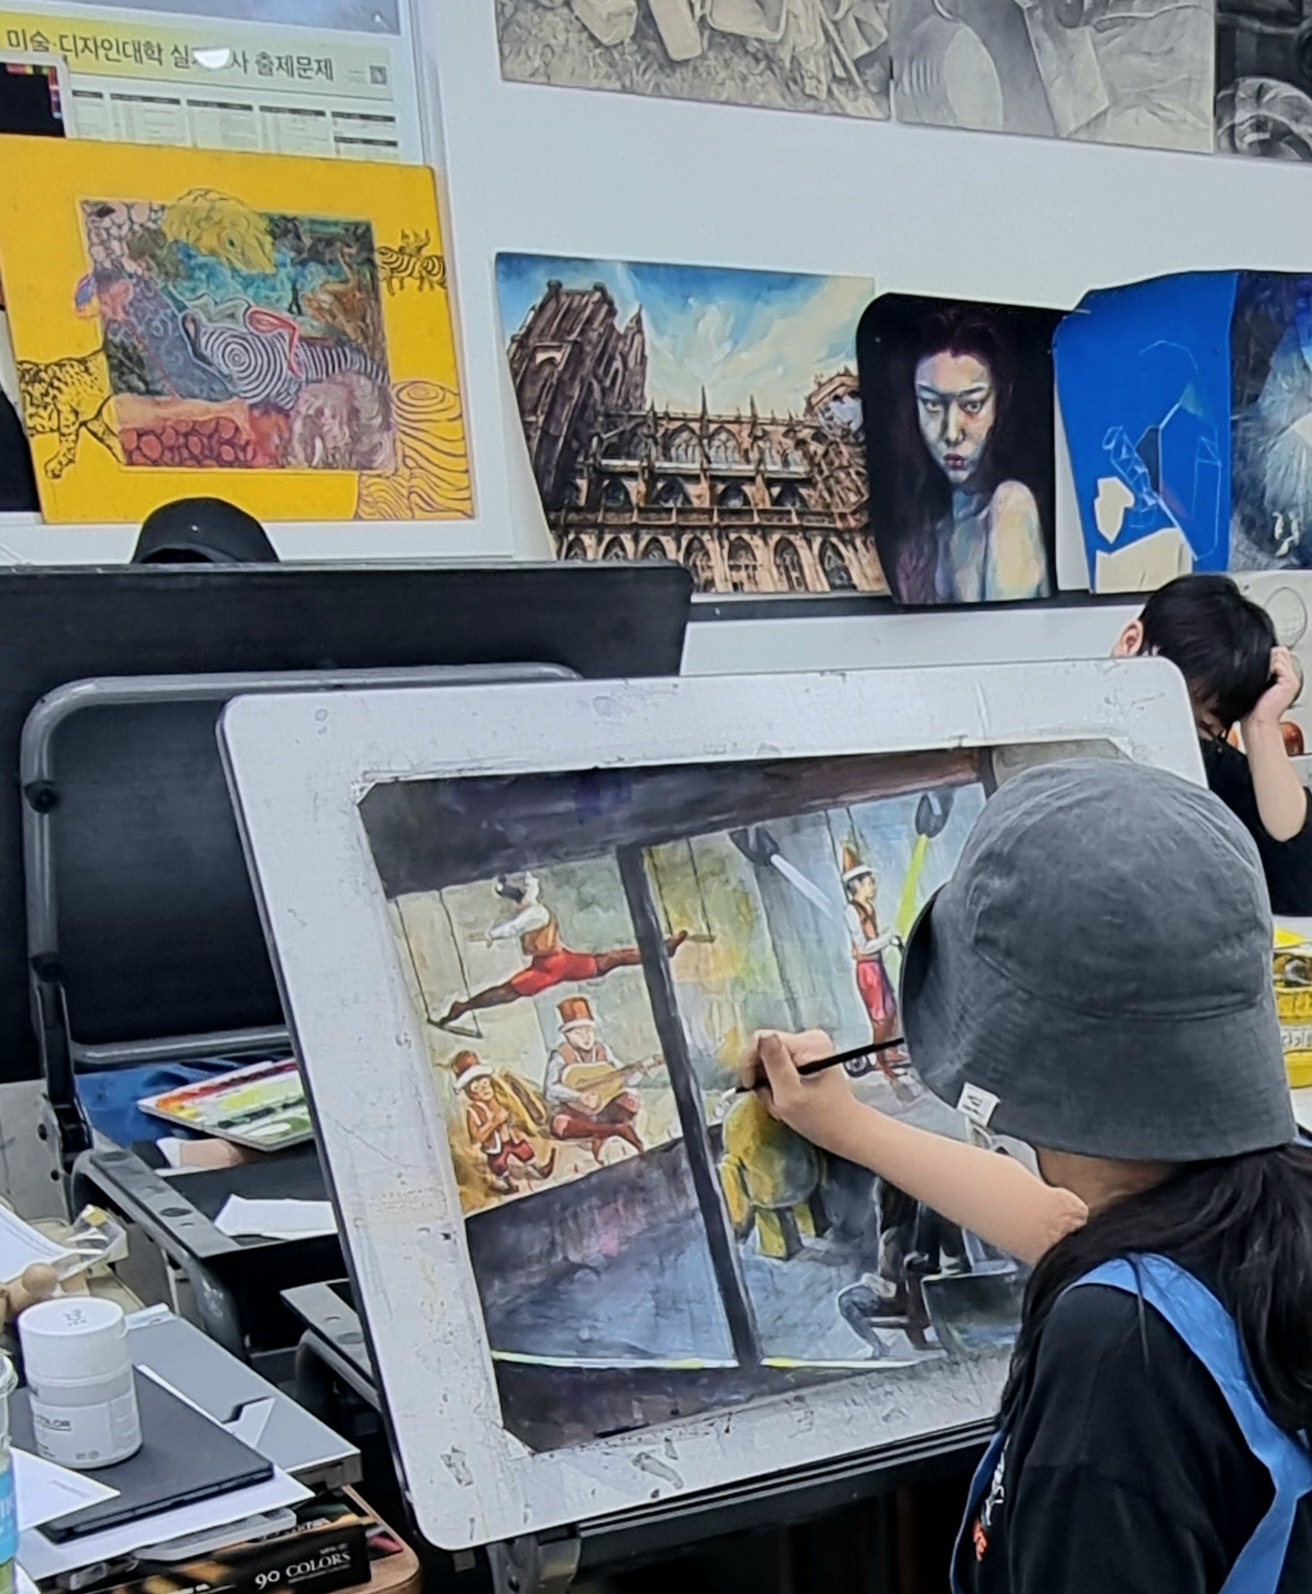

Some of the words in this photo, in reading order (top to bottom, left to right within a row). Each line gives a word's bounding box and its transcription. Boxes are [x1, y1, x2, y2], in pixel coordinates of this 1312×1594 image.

[170, 44, 249, 75] 실사
[254, 51, 334, 81] 출제문제
[254, 1569, 281, 1591] 90
[285, 1551, 351, 1577] COLORS
